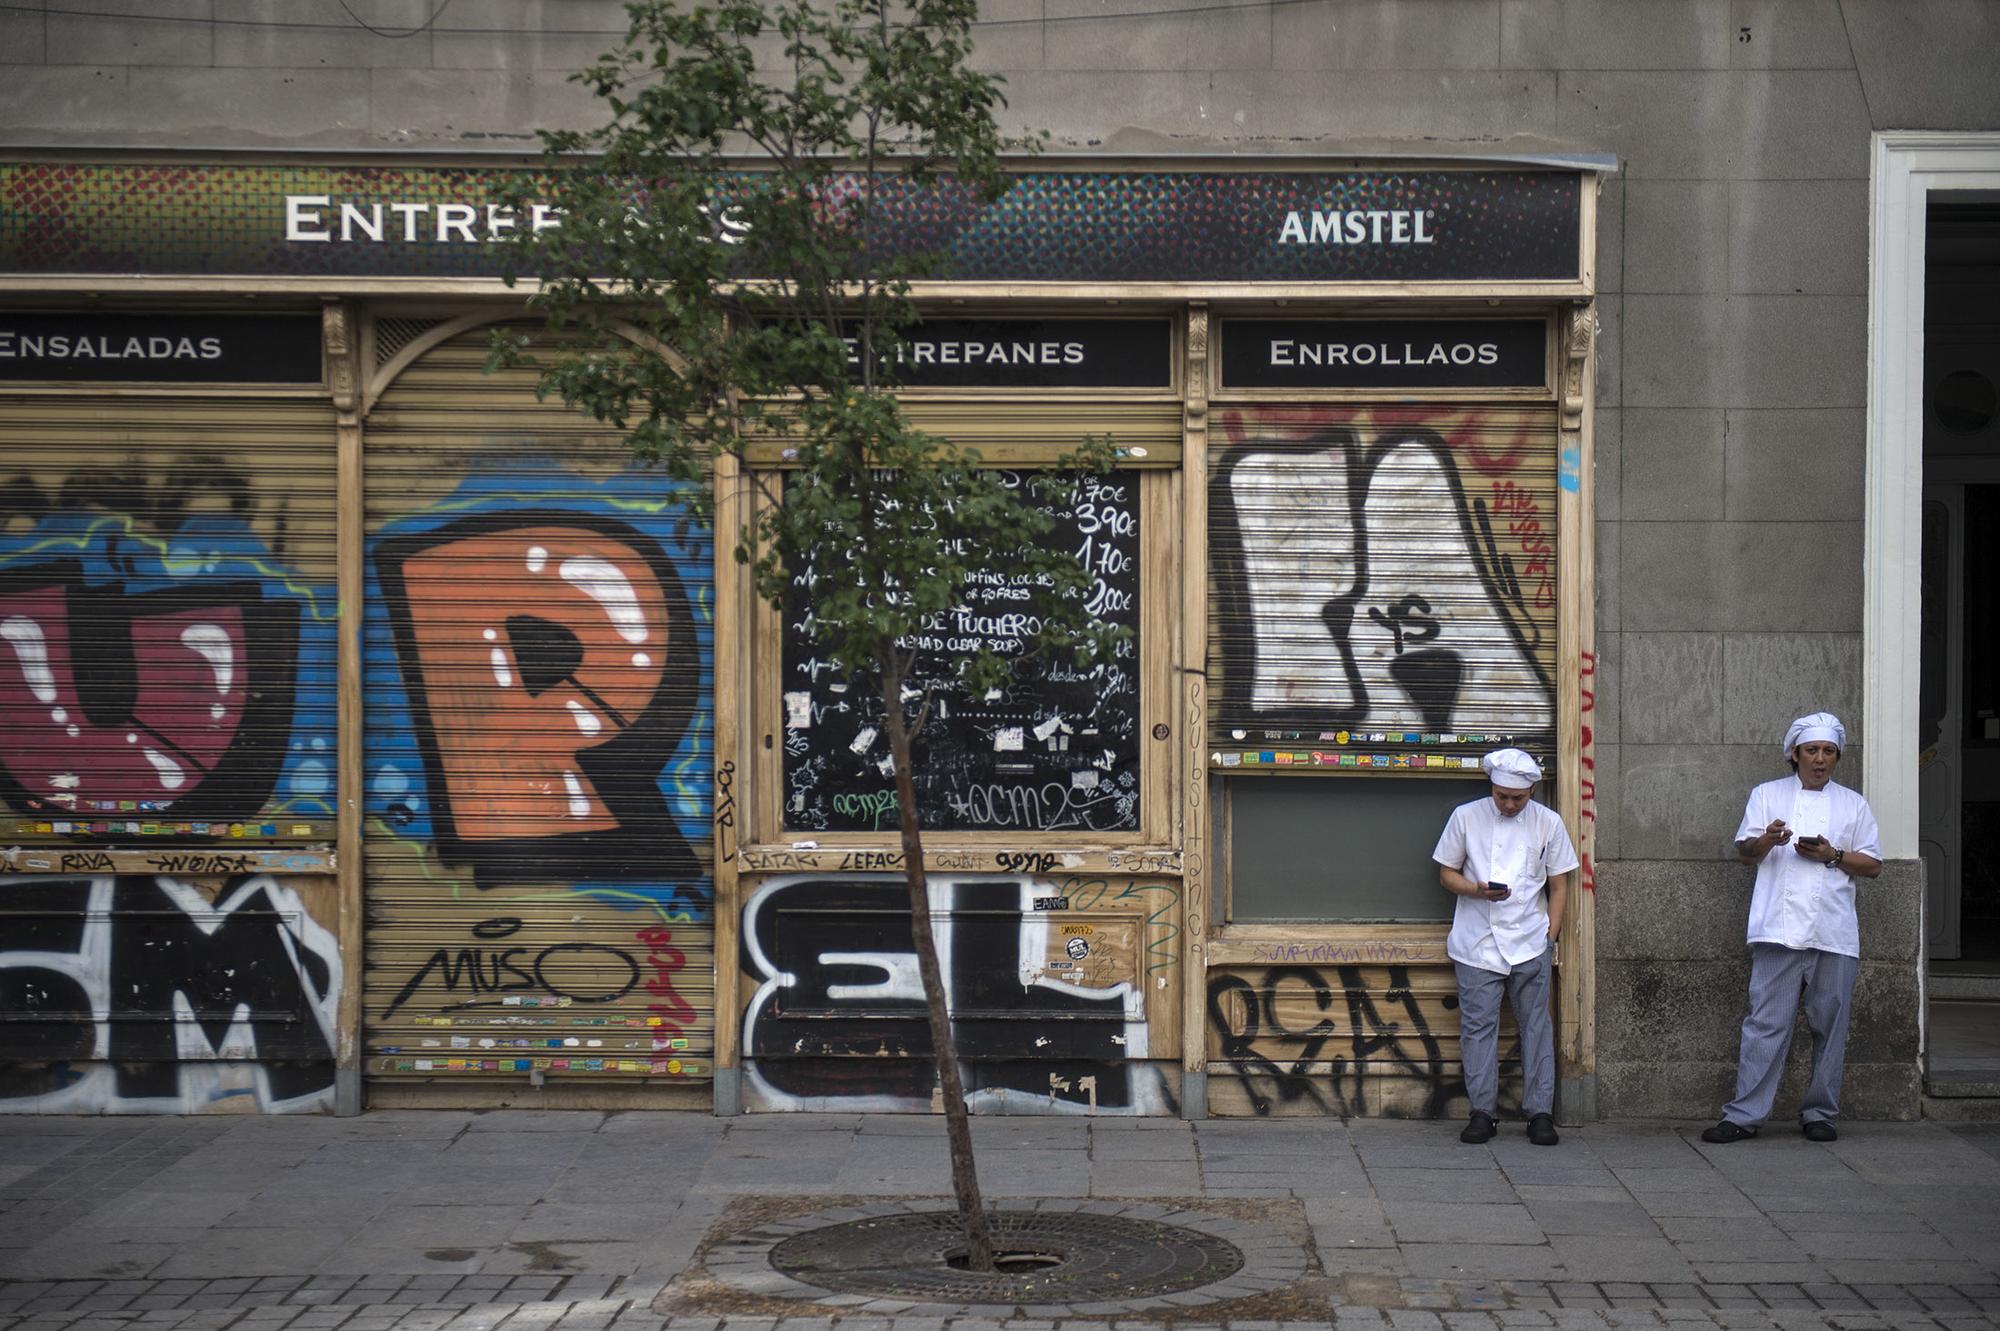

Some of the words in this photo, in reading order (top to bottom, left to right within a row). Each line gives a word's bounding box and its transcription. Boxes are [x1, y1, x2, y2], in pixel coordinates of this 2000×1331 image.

[1270, 339, 1498, 365] ENROLLAOS
[1075, 503, 1136, 538] 3,90€
[1075, 535, 1133, 577] 1,70€
[1083, 578, 1133, 616] 2,00€
